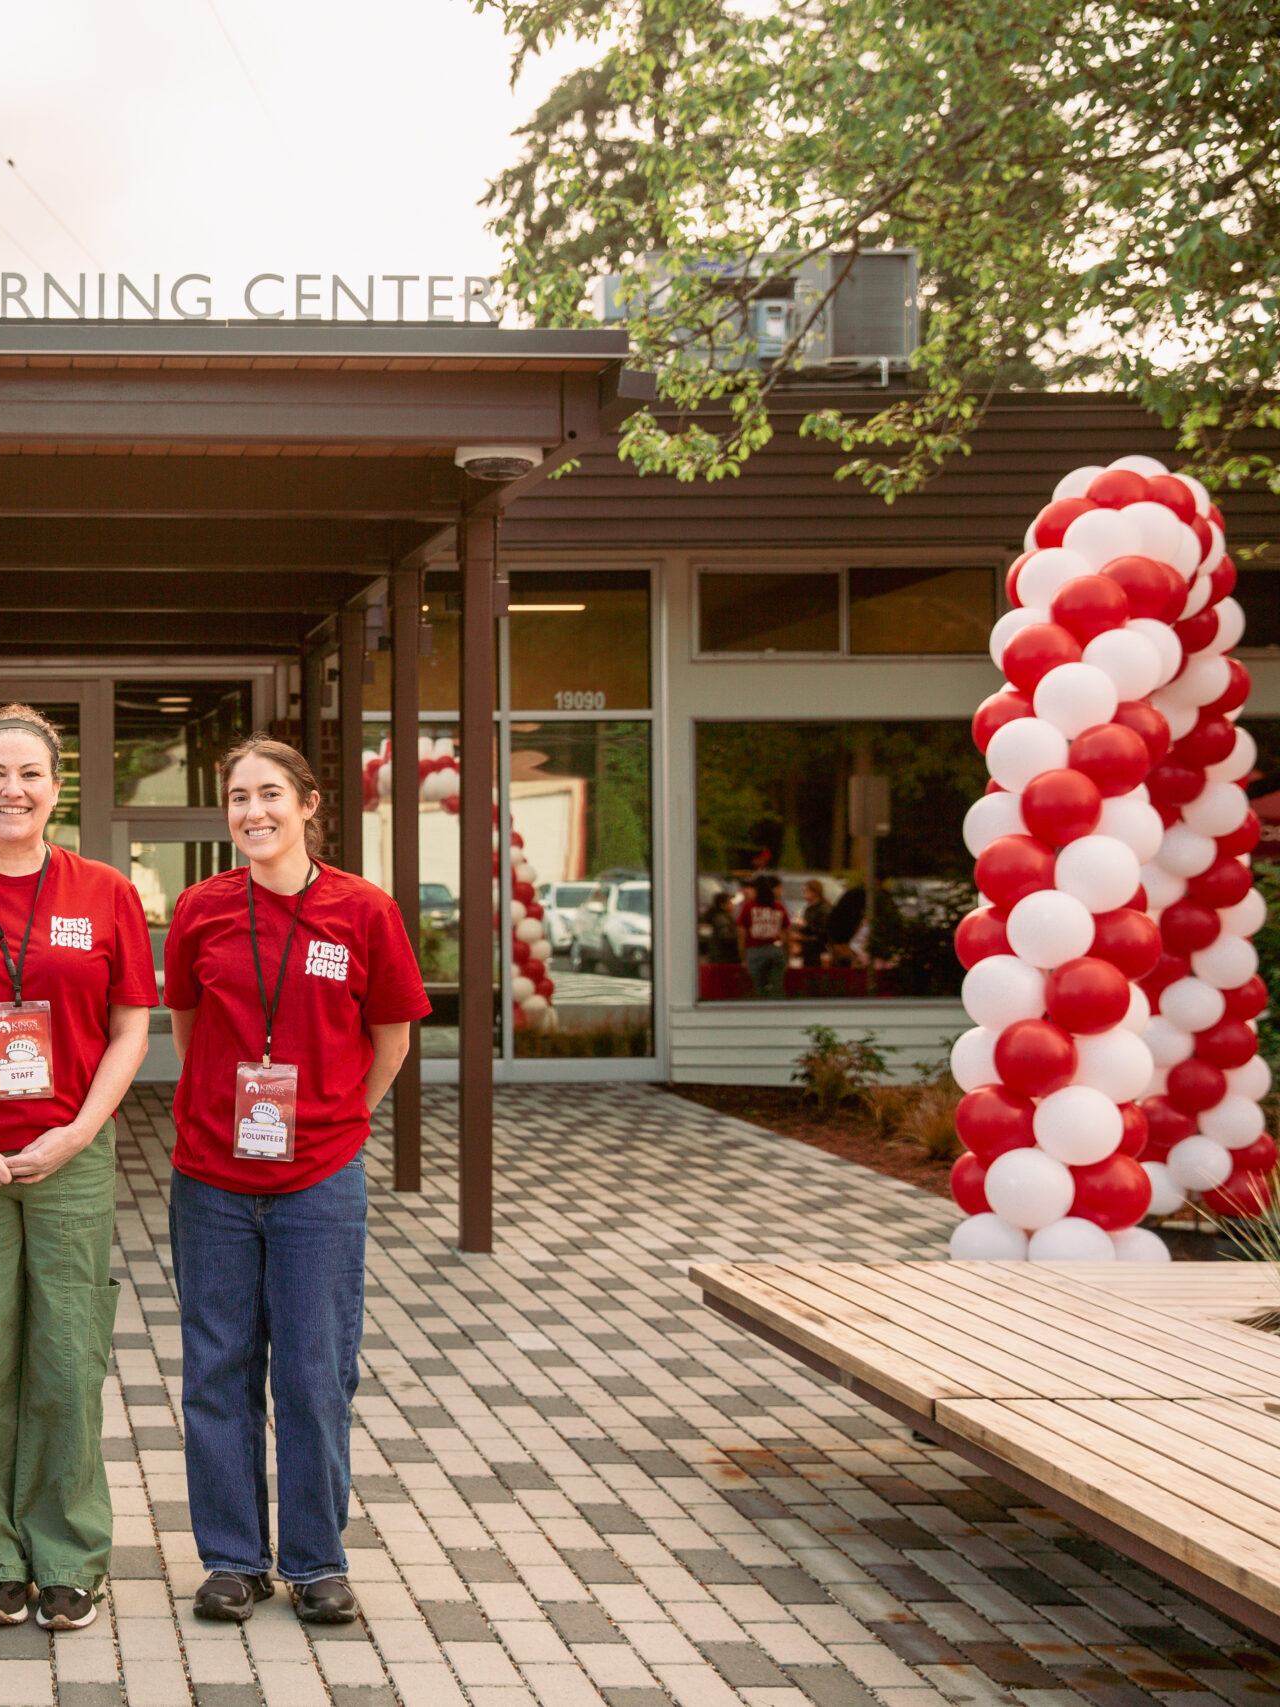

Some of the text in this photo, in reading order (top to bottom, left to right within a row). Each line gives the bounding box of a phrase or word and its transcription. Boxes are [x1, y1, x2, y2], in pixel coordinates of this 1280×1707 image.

[243, 273, 499, 322] CENTER
[554, 691, 606, 710] 19090
[10, 1071, 34, 1080] STAFF
[241, 1131, 284, 1143] VOLUNTEER
